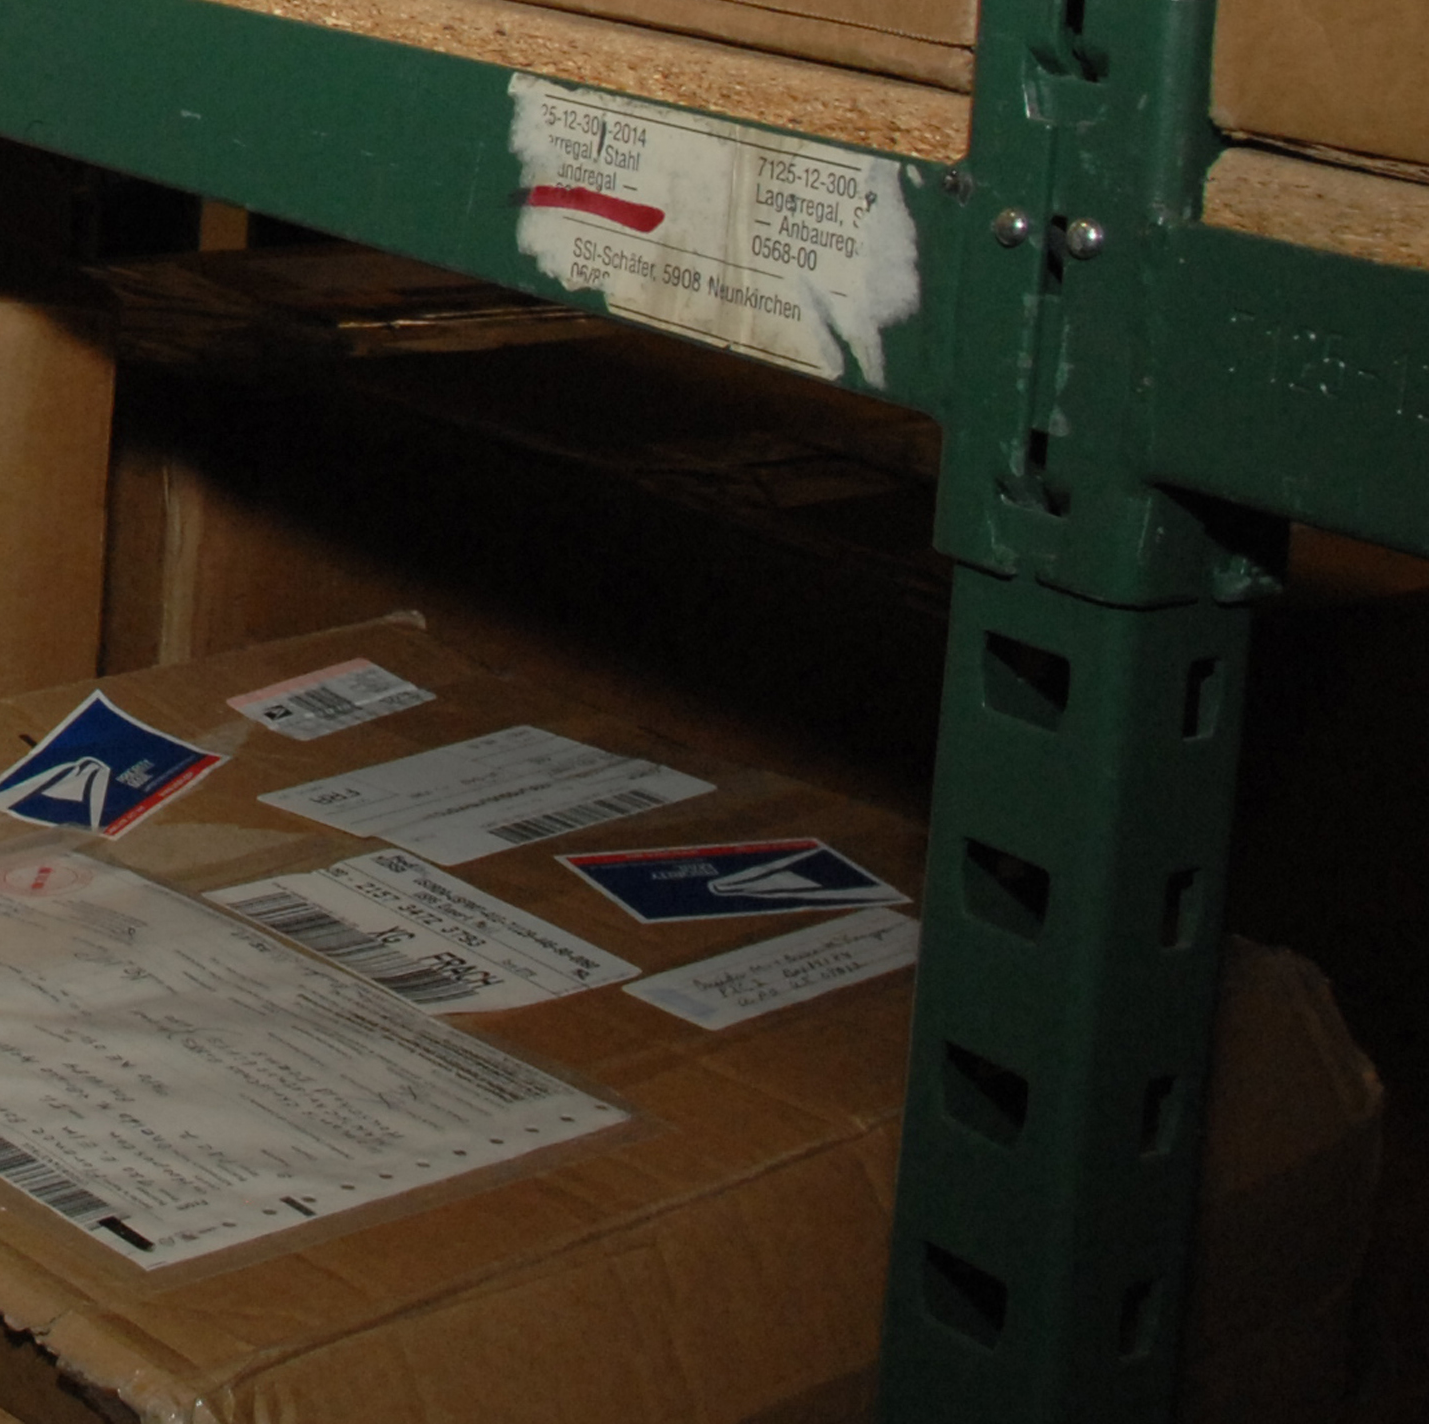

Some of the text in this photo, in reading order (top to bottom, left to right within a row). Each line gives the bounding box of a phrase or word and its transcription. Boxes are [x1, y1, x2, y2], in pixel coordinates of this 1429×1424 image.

[603, 143, 640, 171] Stahl
[751, 235, 817, 271] 0568-00
[779, 216, 861, 257] Anbaureg
[662, 263, 701, 292] 5908
[708, 277, 801, 322] Neunkirchen
